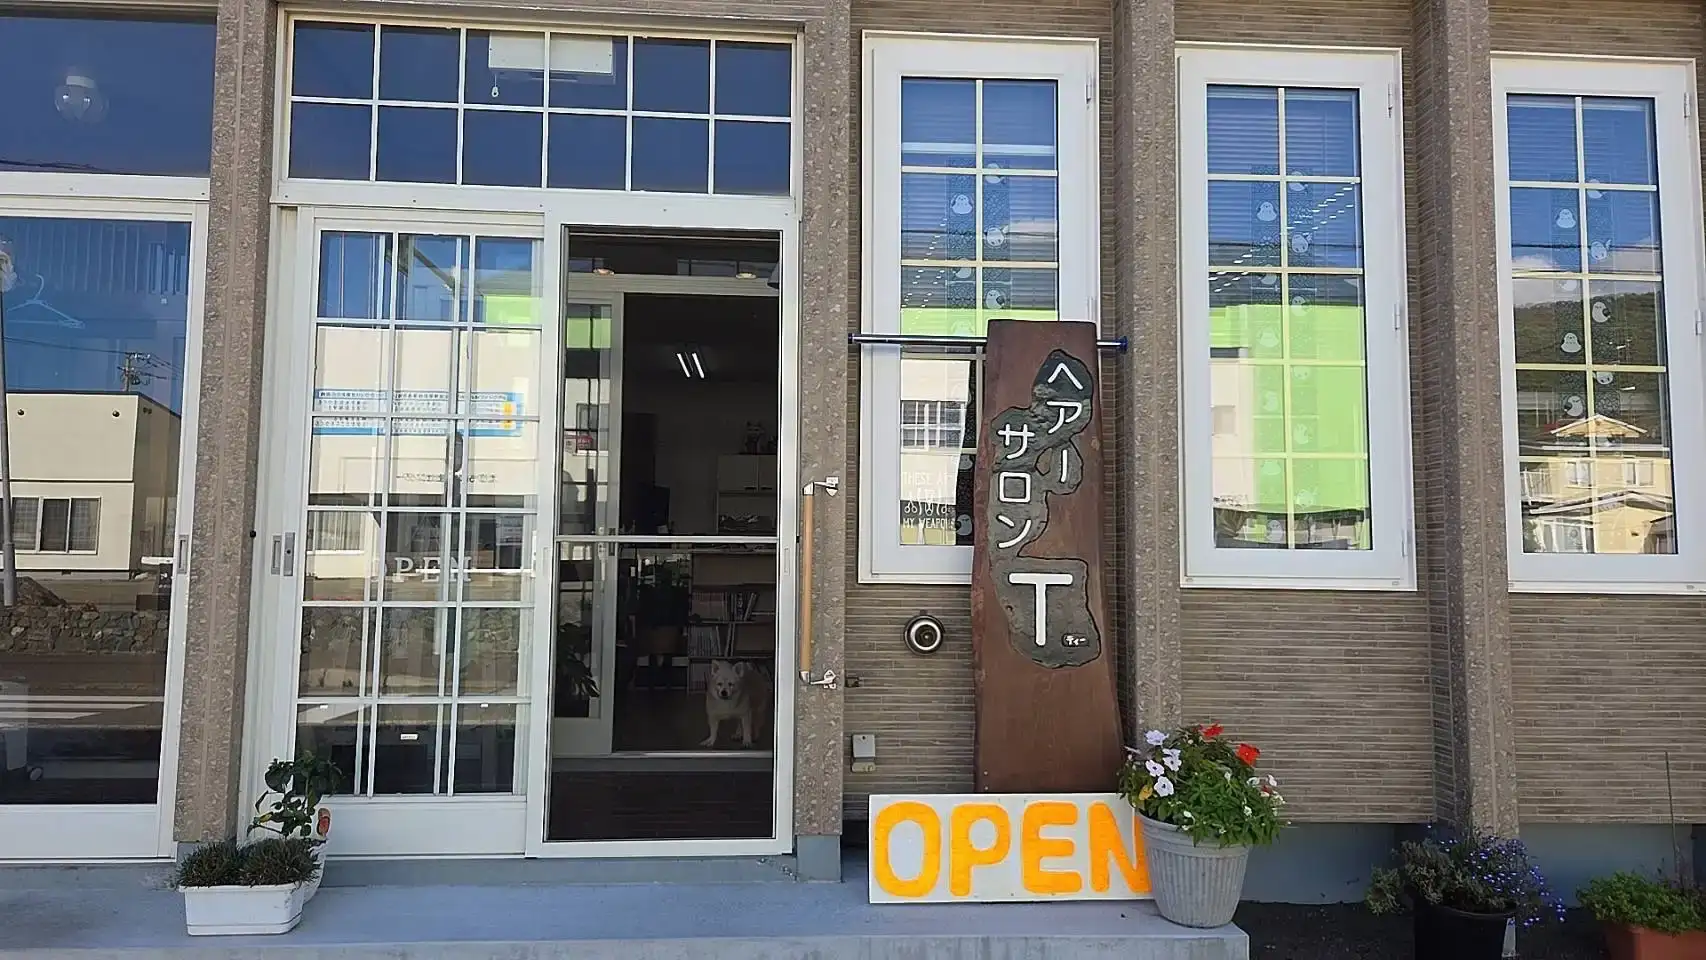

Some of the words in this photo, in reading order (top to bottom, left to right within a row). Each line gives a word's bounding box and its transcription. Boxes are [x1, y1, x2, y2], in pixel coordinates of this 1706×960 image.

[1047, 361, 1084, 483] ヘアー
[903, 518, 915, 529] MY
[997, 423, 1036, 549] サロン
[1009, 573, 1073, 646] T
[873, 800, 1153, 898] OPEN
